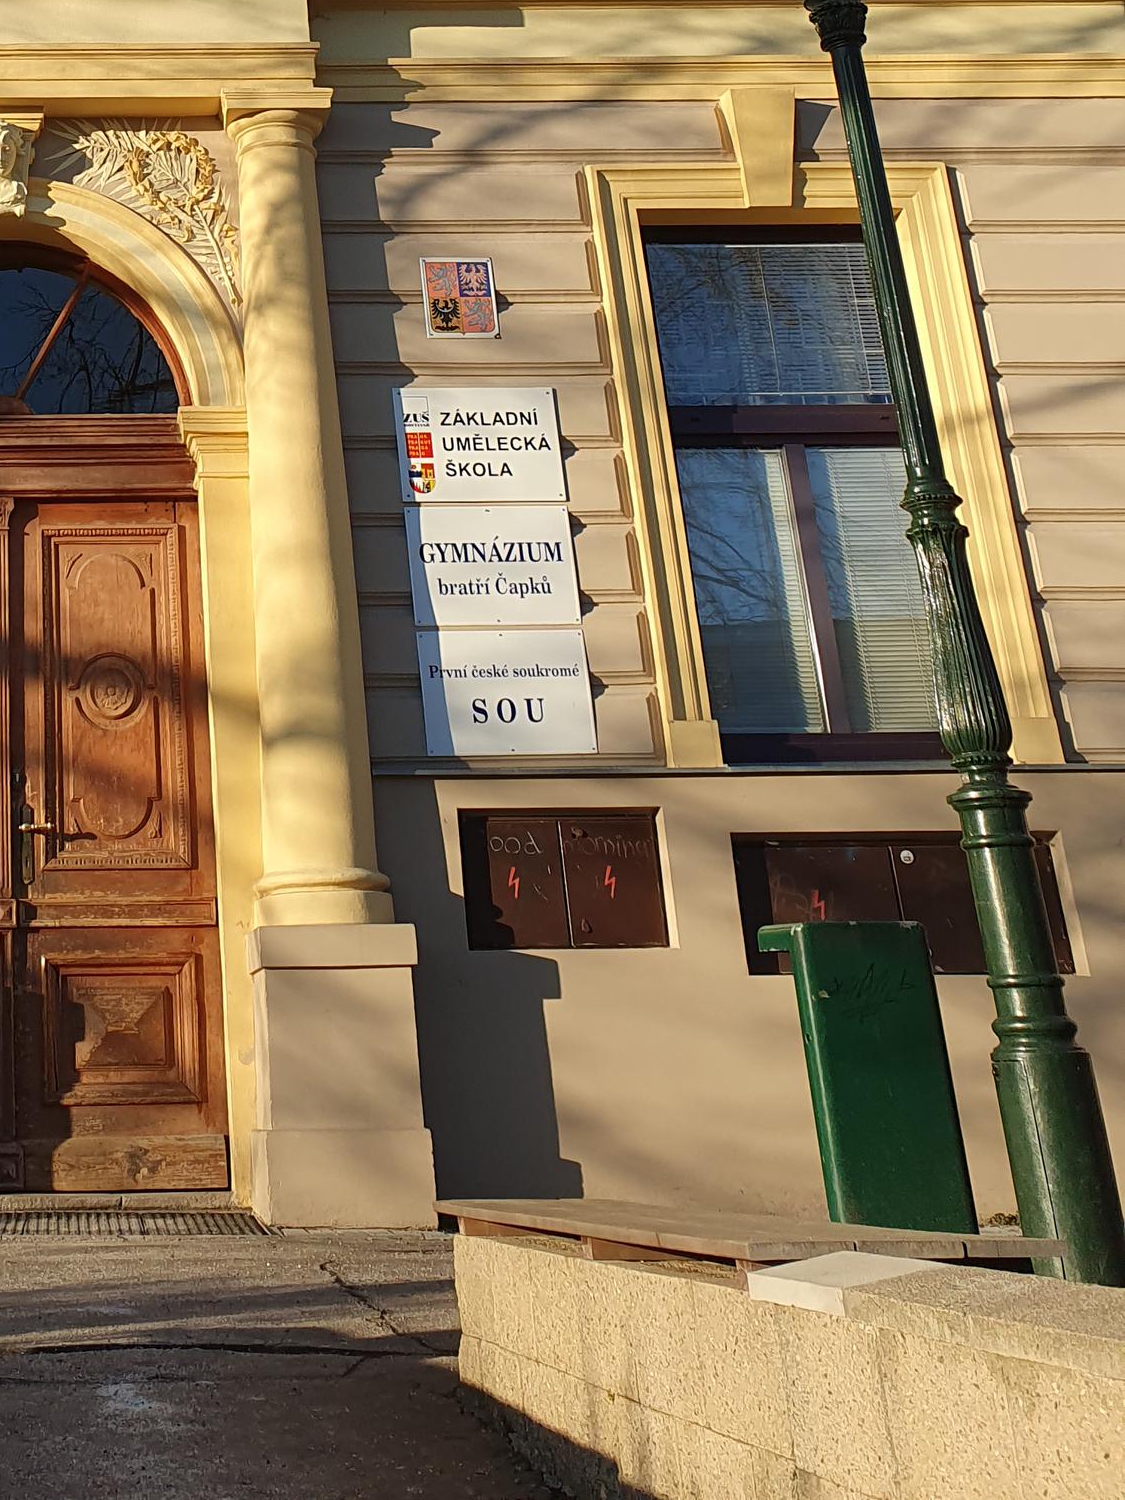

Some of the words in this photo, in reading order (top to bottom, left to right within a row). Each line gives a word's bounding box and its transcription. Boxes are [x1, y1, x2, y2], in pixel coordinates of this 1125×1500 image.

[403, 411, 430, 423] ZUŠ
[440, 408, 538, 427] ZÁKLADNÍ
[442, 433, 552, 452] UMĚLECKÁ
[445, 459, 514, 477] ŠKOLA
[419, 536, 564, 563] GYMNÁZIUM
[437, 576, 490, 596] bratří
[495, 572, 553, 599] Čapků
[428, 664, 467, 679] První
[471, 664, 509, 679] české
[512, 663, 580, 678] soukromé
